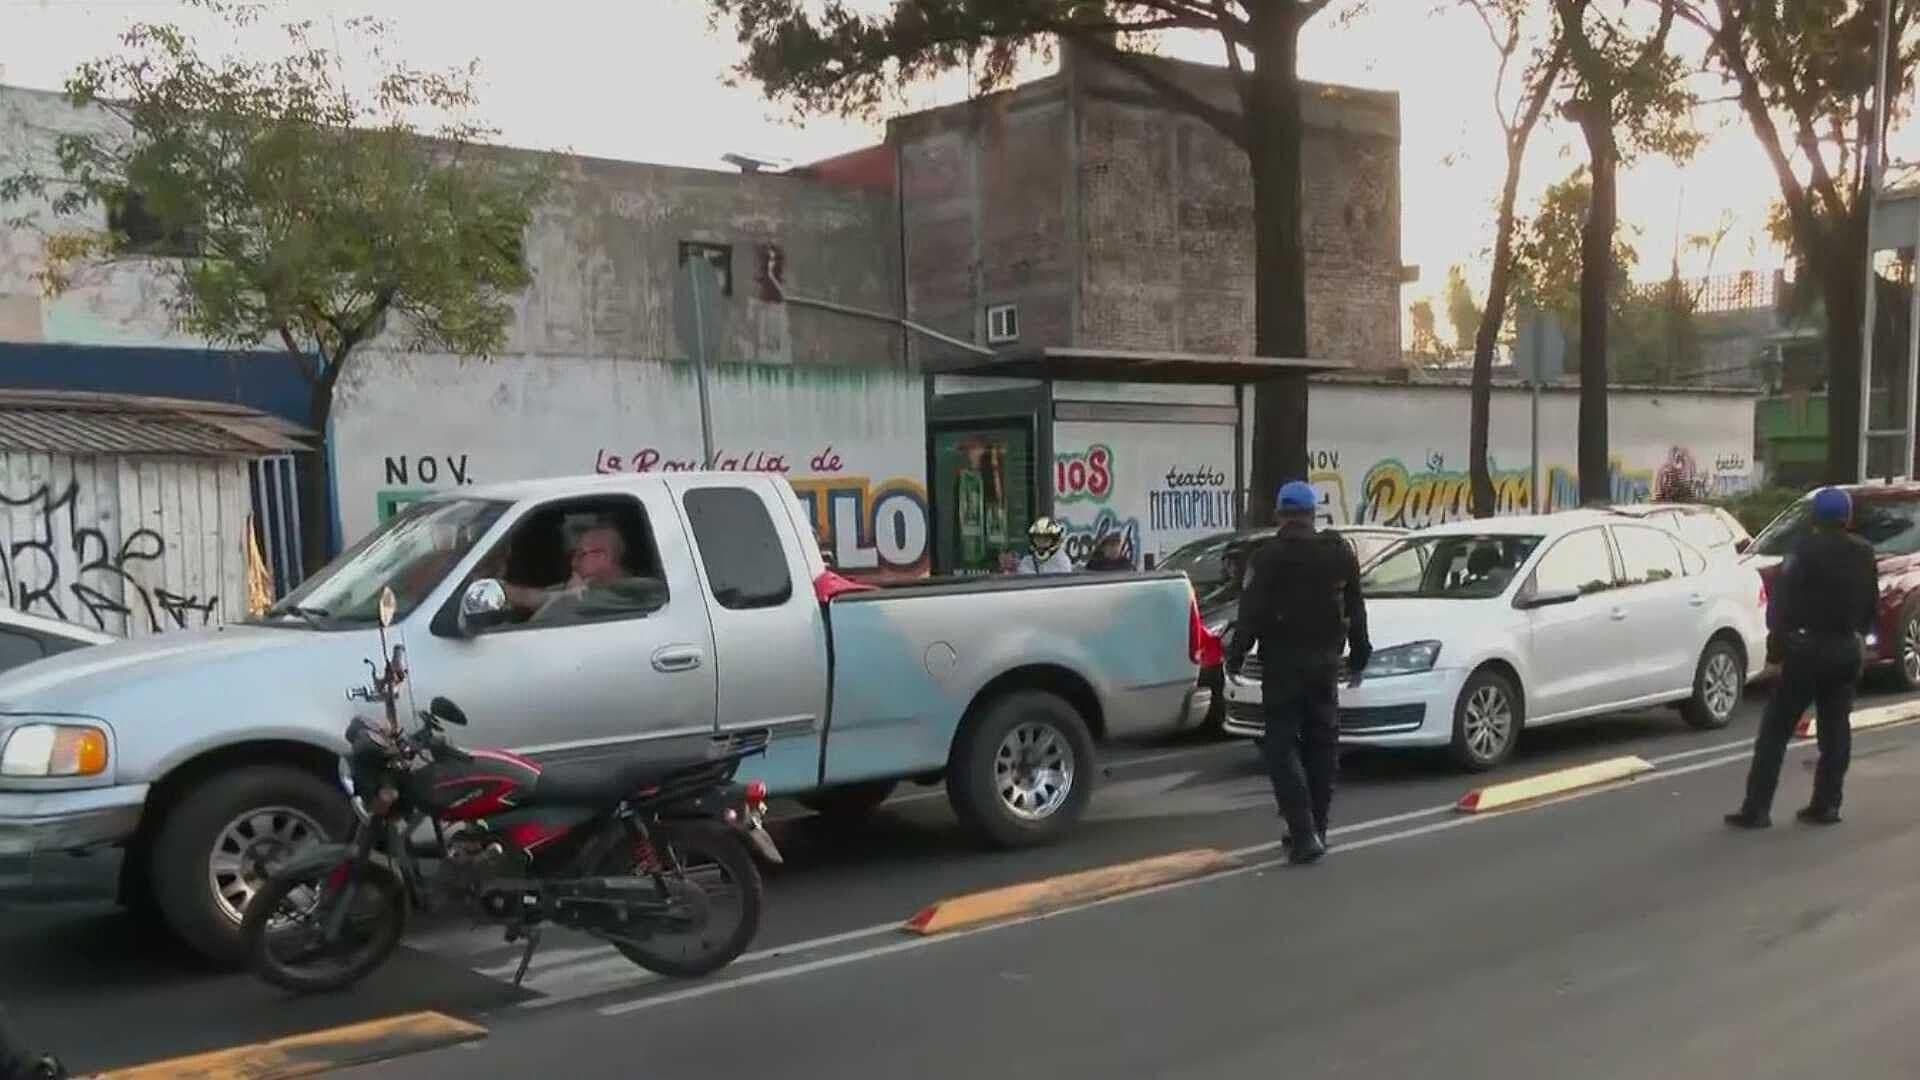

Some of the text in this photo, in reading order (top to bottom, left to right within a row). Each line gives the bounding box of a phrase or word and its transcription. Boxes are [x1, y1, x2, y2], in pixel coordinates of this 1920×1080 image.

[596, 449, 622, 474] La
[811, 446, 843, 471] de
[1166, 465, 1225, 488] teatro
